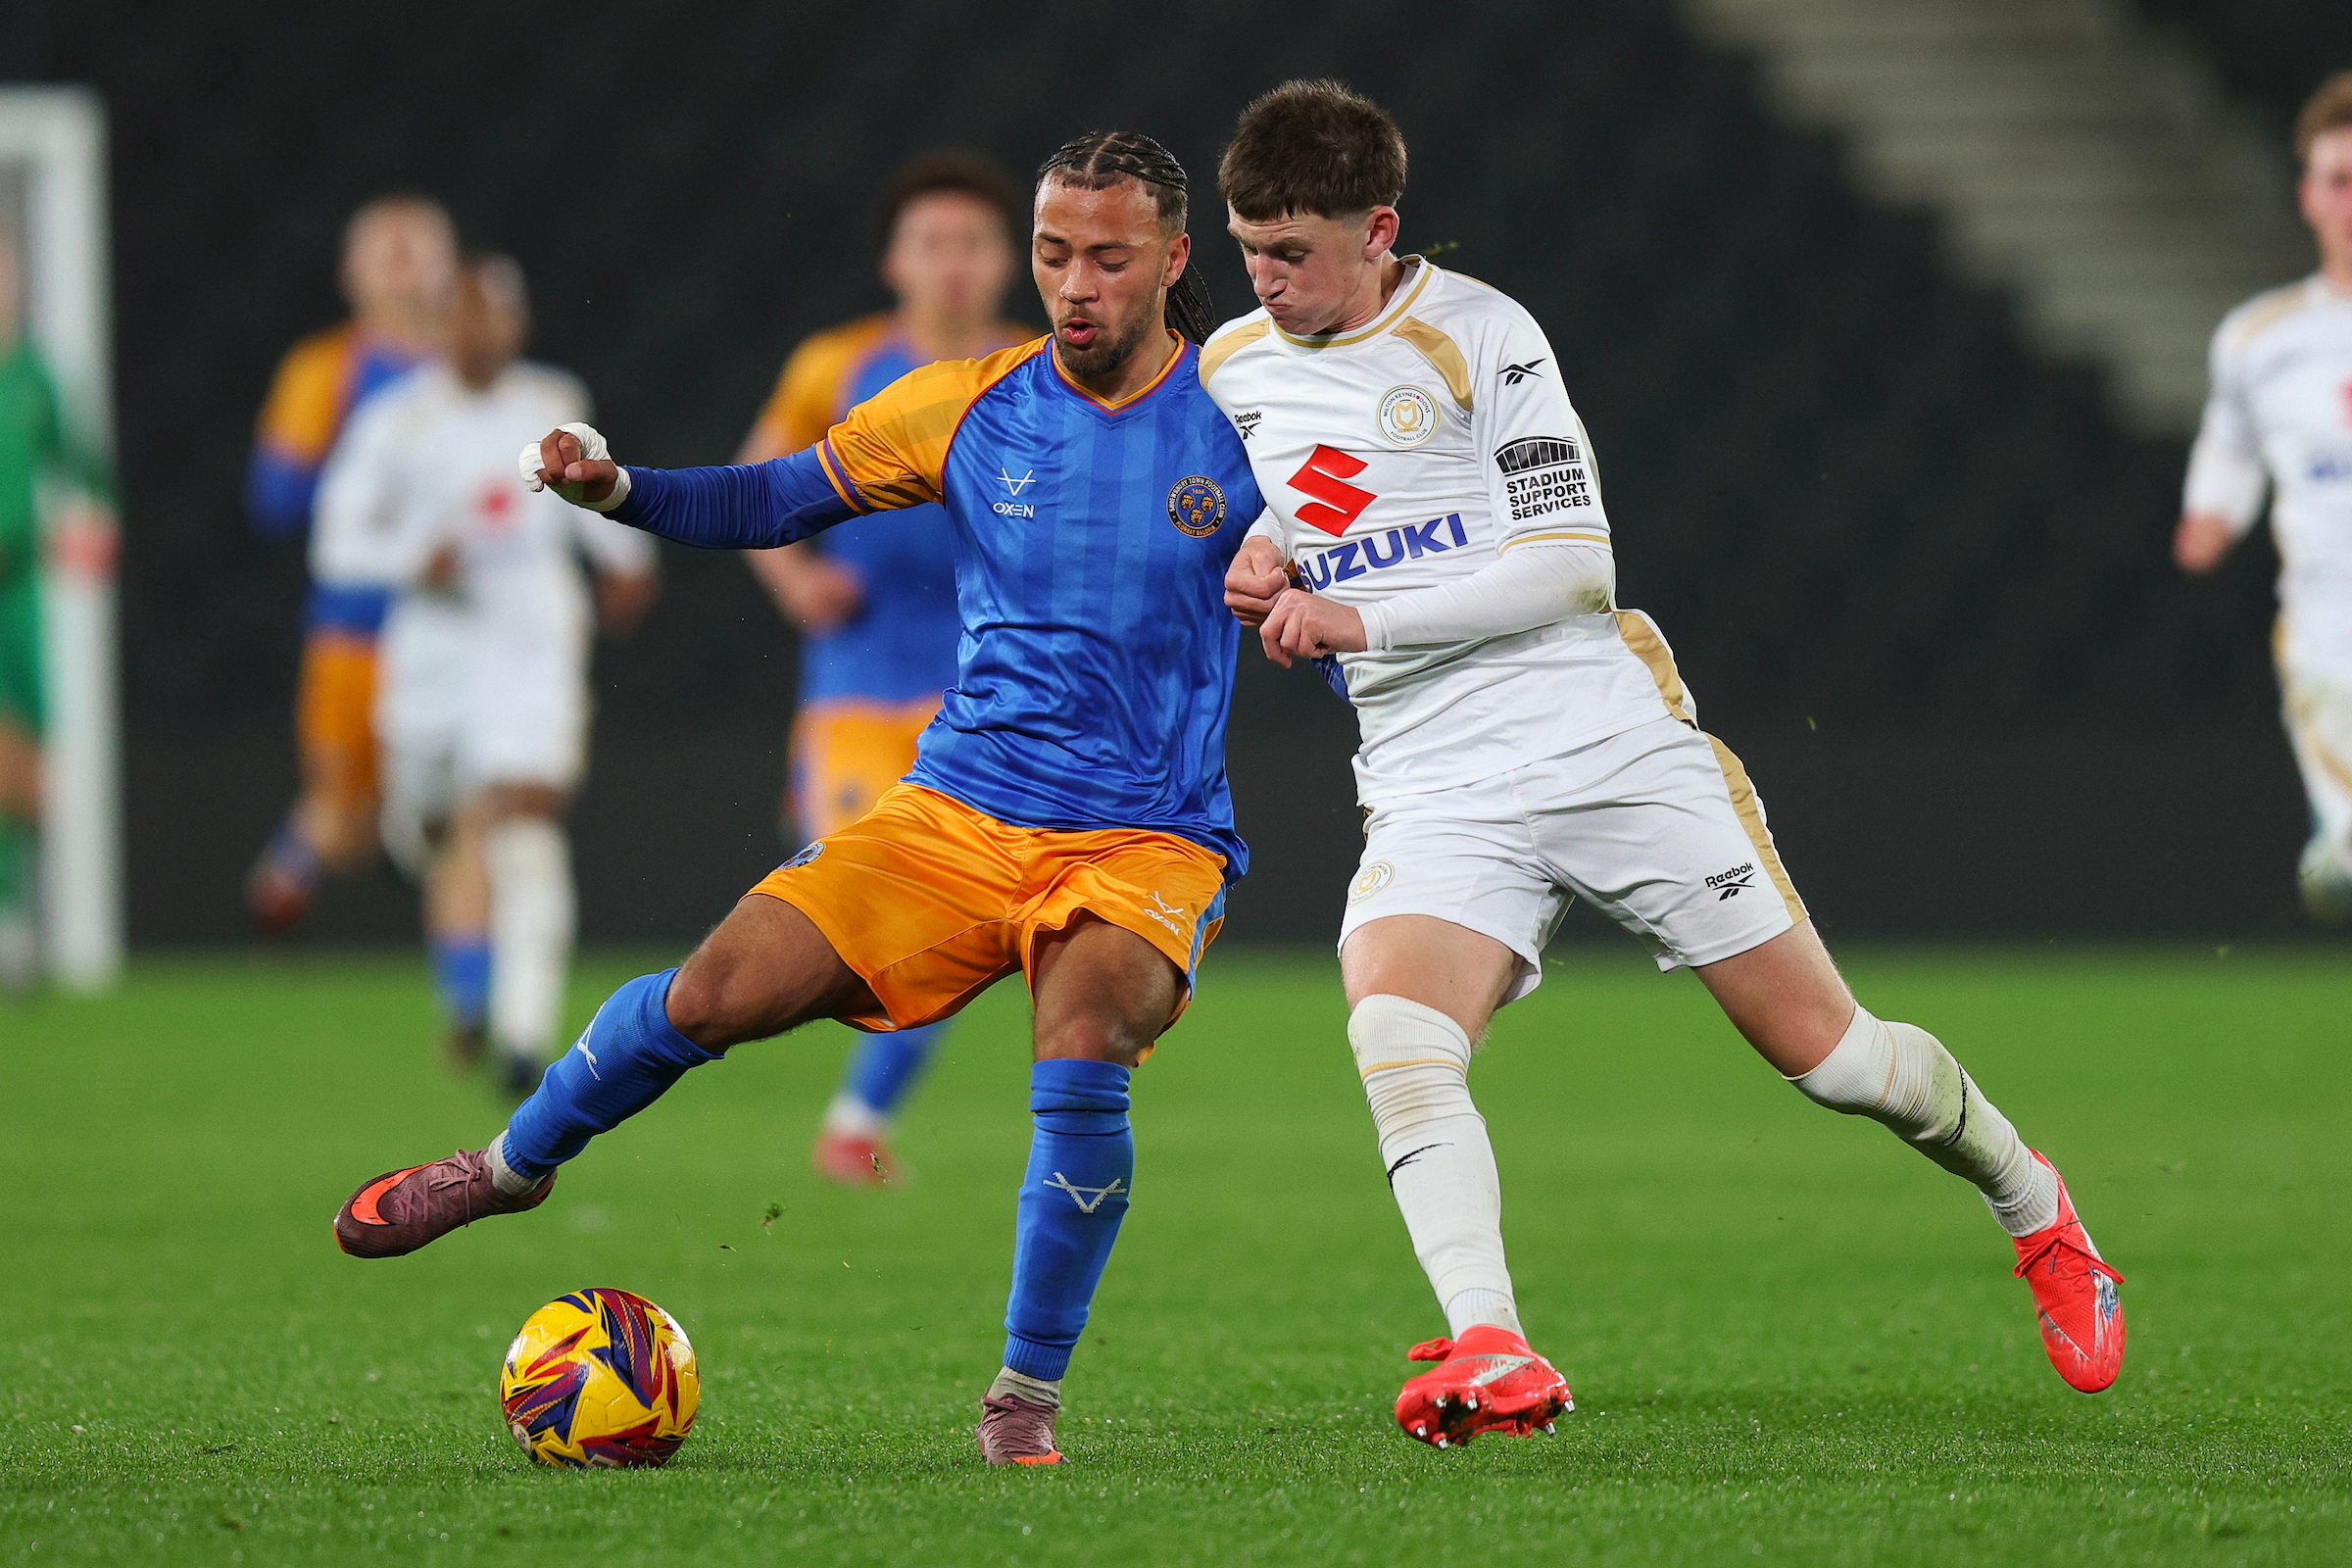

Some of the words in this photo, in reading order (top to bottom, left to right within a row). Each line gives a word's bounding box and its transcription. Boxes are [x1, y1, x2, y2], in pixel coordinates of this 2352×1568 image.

[1234, 411, 1262, 425] Reebok
[1383, 397, 1396, 416] MILTON
[1418, 397, 1431, 414] DONS
[1391, 431, 1416, 441] FOOTBALL
[1416, 428, 1428, 439] CLUB
[1204, 480, 1225, 504] FOOTBALL
[1506, 468, 1586, 494] STADIUM
[1509, 482, 1587, 508] SUPPORT
[1511, 495, 1591, 520] SERVICES
[993, 502, 1035, 518] OXEN
[1297, 513, 1469, 594] SUZUKI
[1704, 861, 1754, 888] Reebok
[1143, 907, 1180, 936] OXEN
